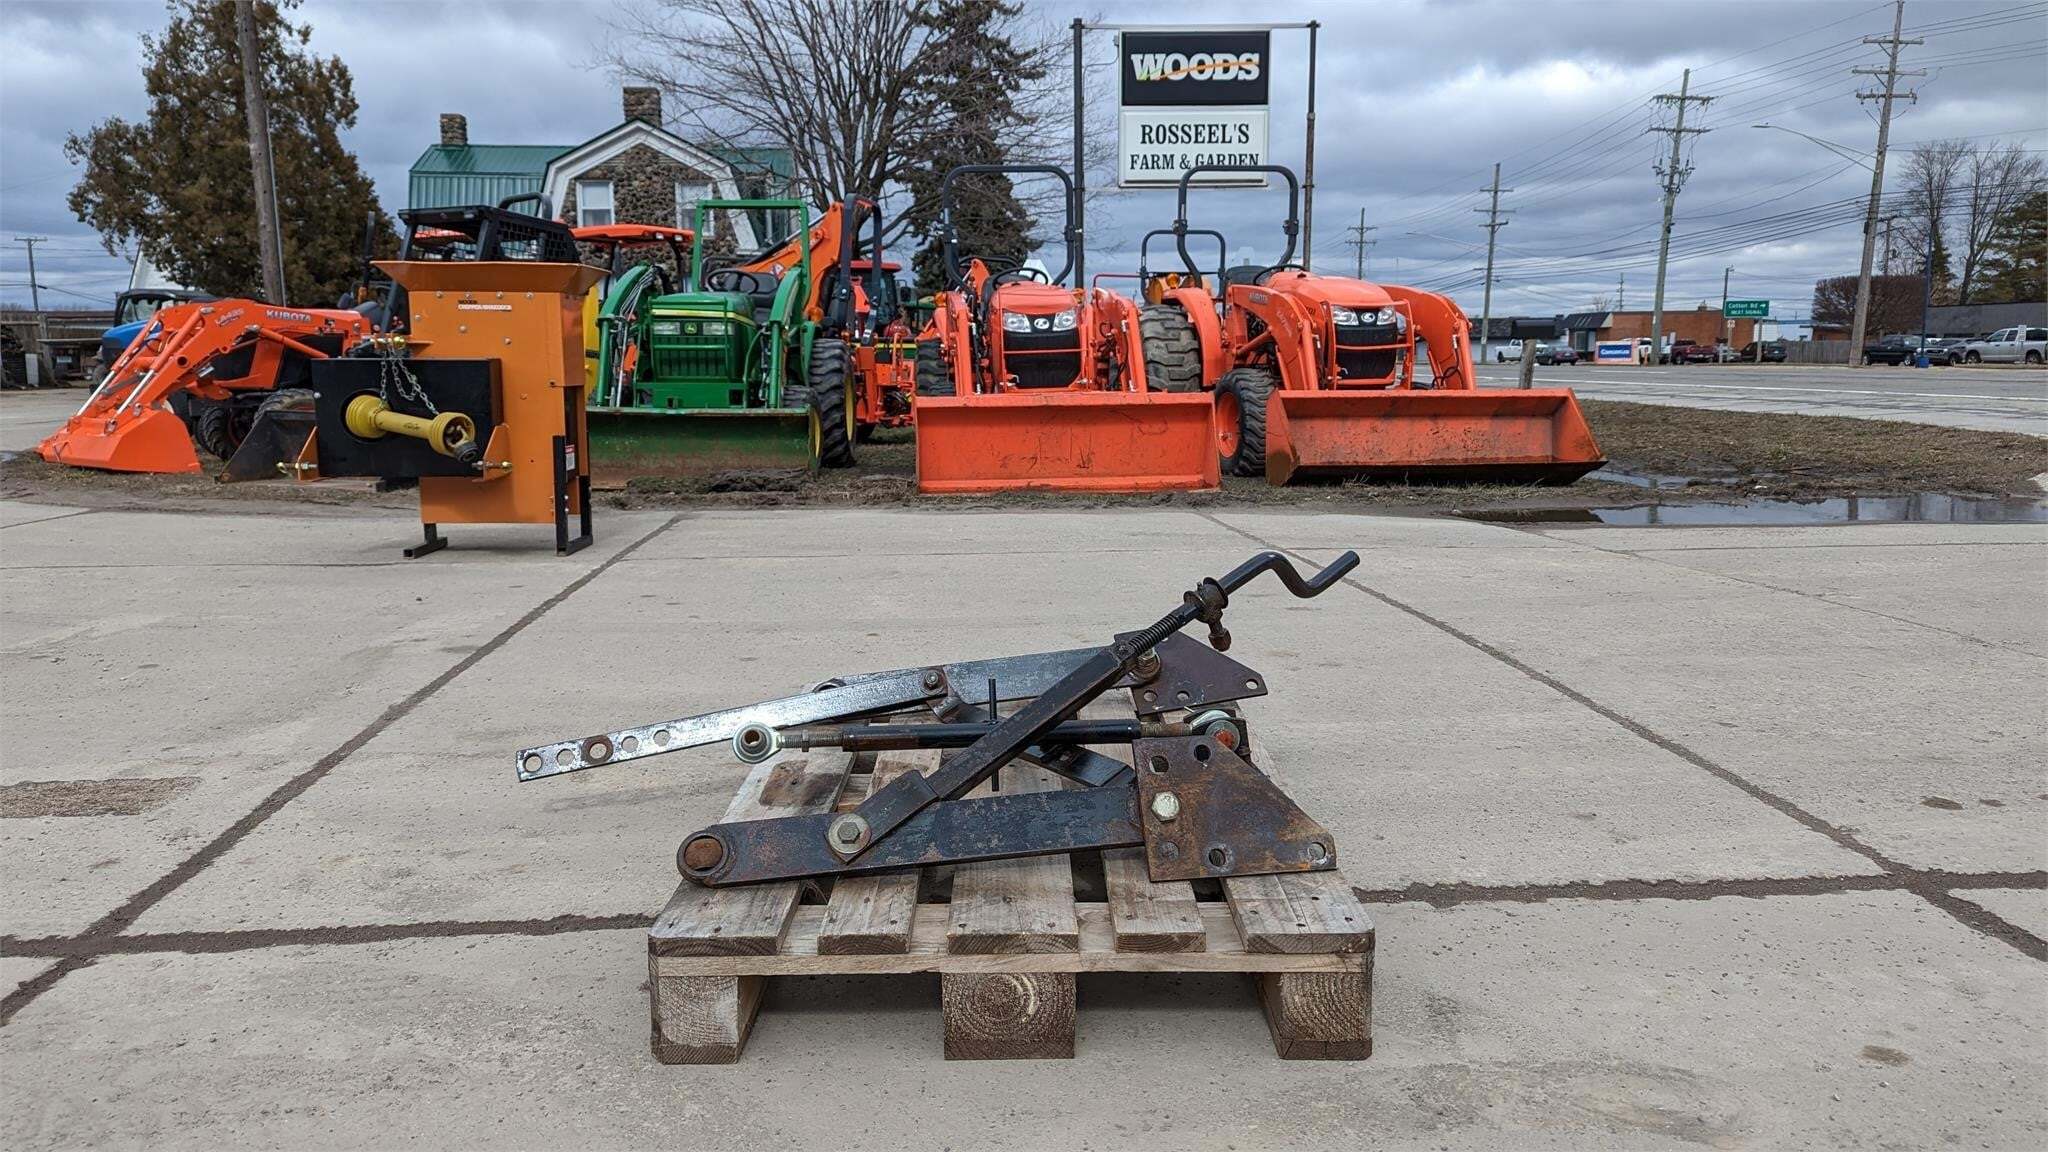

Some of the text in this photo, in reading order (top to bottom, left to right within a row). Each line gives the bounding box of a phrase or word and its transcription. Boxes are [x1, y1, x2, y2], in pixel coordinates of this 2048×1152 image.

[1130, 52, 1260, 81] WOODS
[1140, 123, 1250, 145] ROSSEEL'S
[1129, 153, 1260, 170] FARM & GARDEN
[266, 309, 312, 323] KUBOTA
